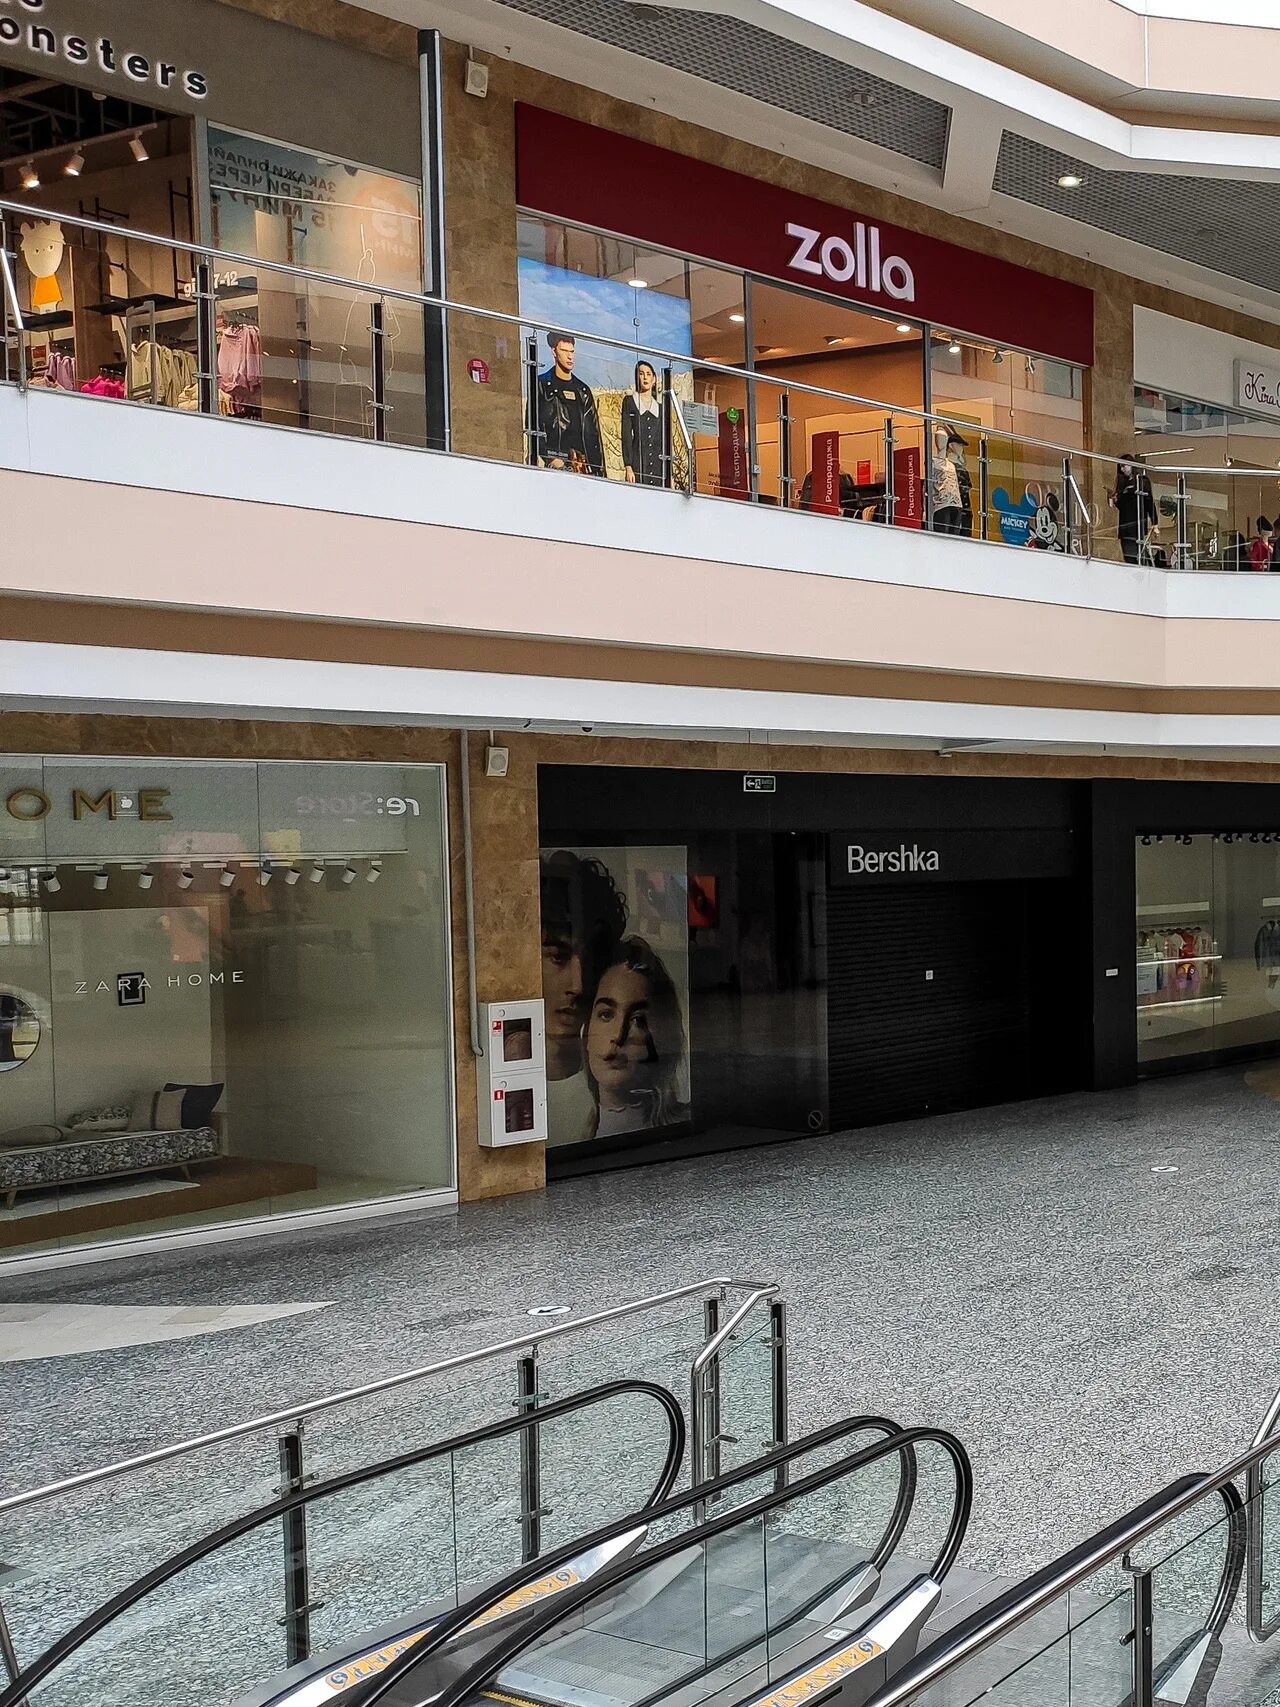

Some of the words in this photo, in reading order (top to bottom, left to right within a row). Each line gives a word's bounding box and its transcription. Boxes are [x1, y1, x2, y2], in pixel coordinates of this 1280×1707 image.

[785, 221, 915, 302] zolla
[1245, 371, 1276, 406] Kira
[825, 438, 833, 503] Распродажа
[1001, 516, 1028, 530] MICKEY
[847, 844, 940, 874] Bershka
[74, 976, 152, 995] ZARA
[167, 970, 245, 988] HOME
